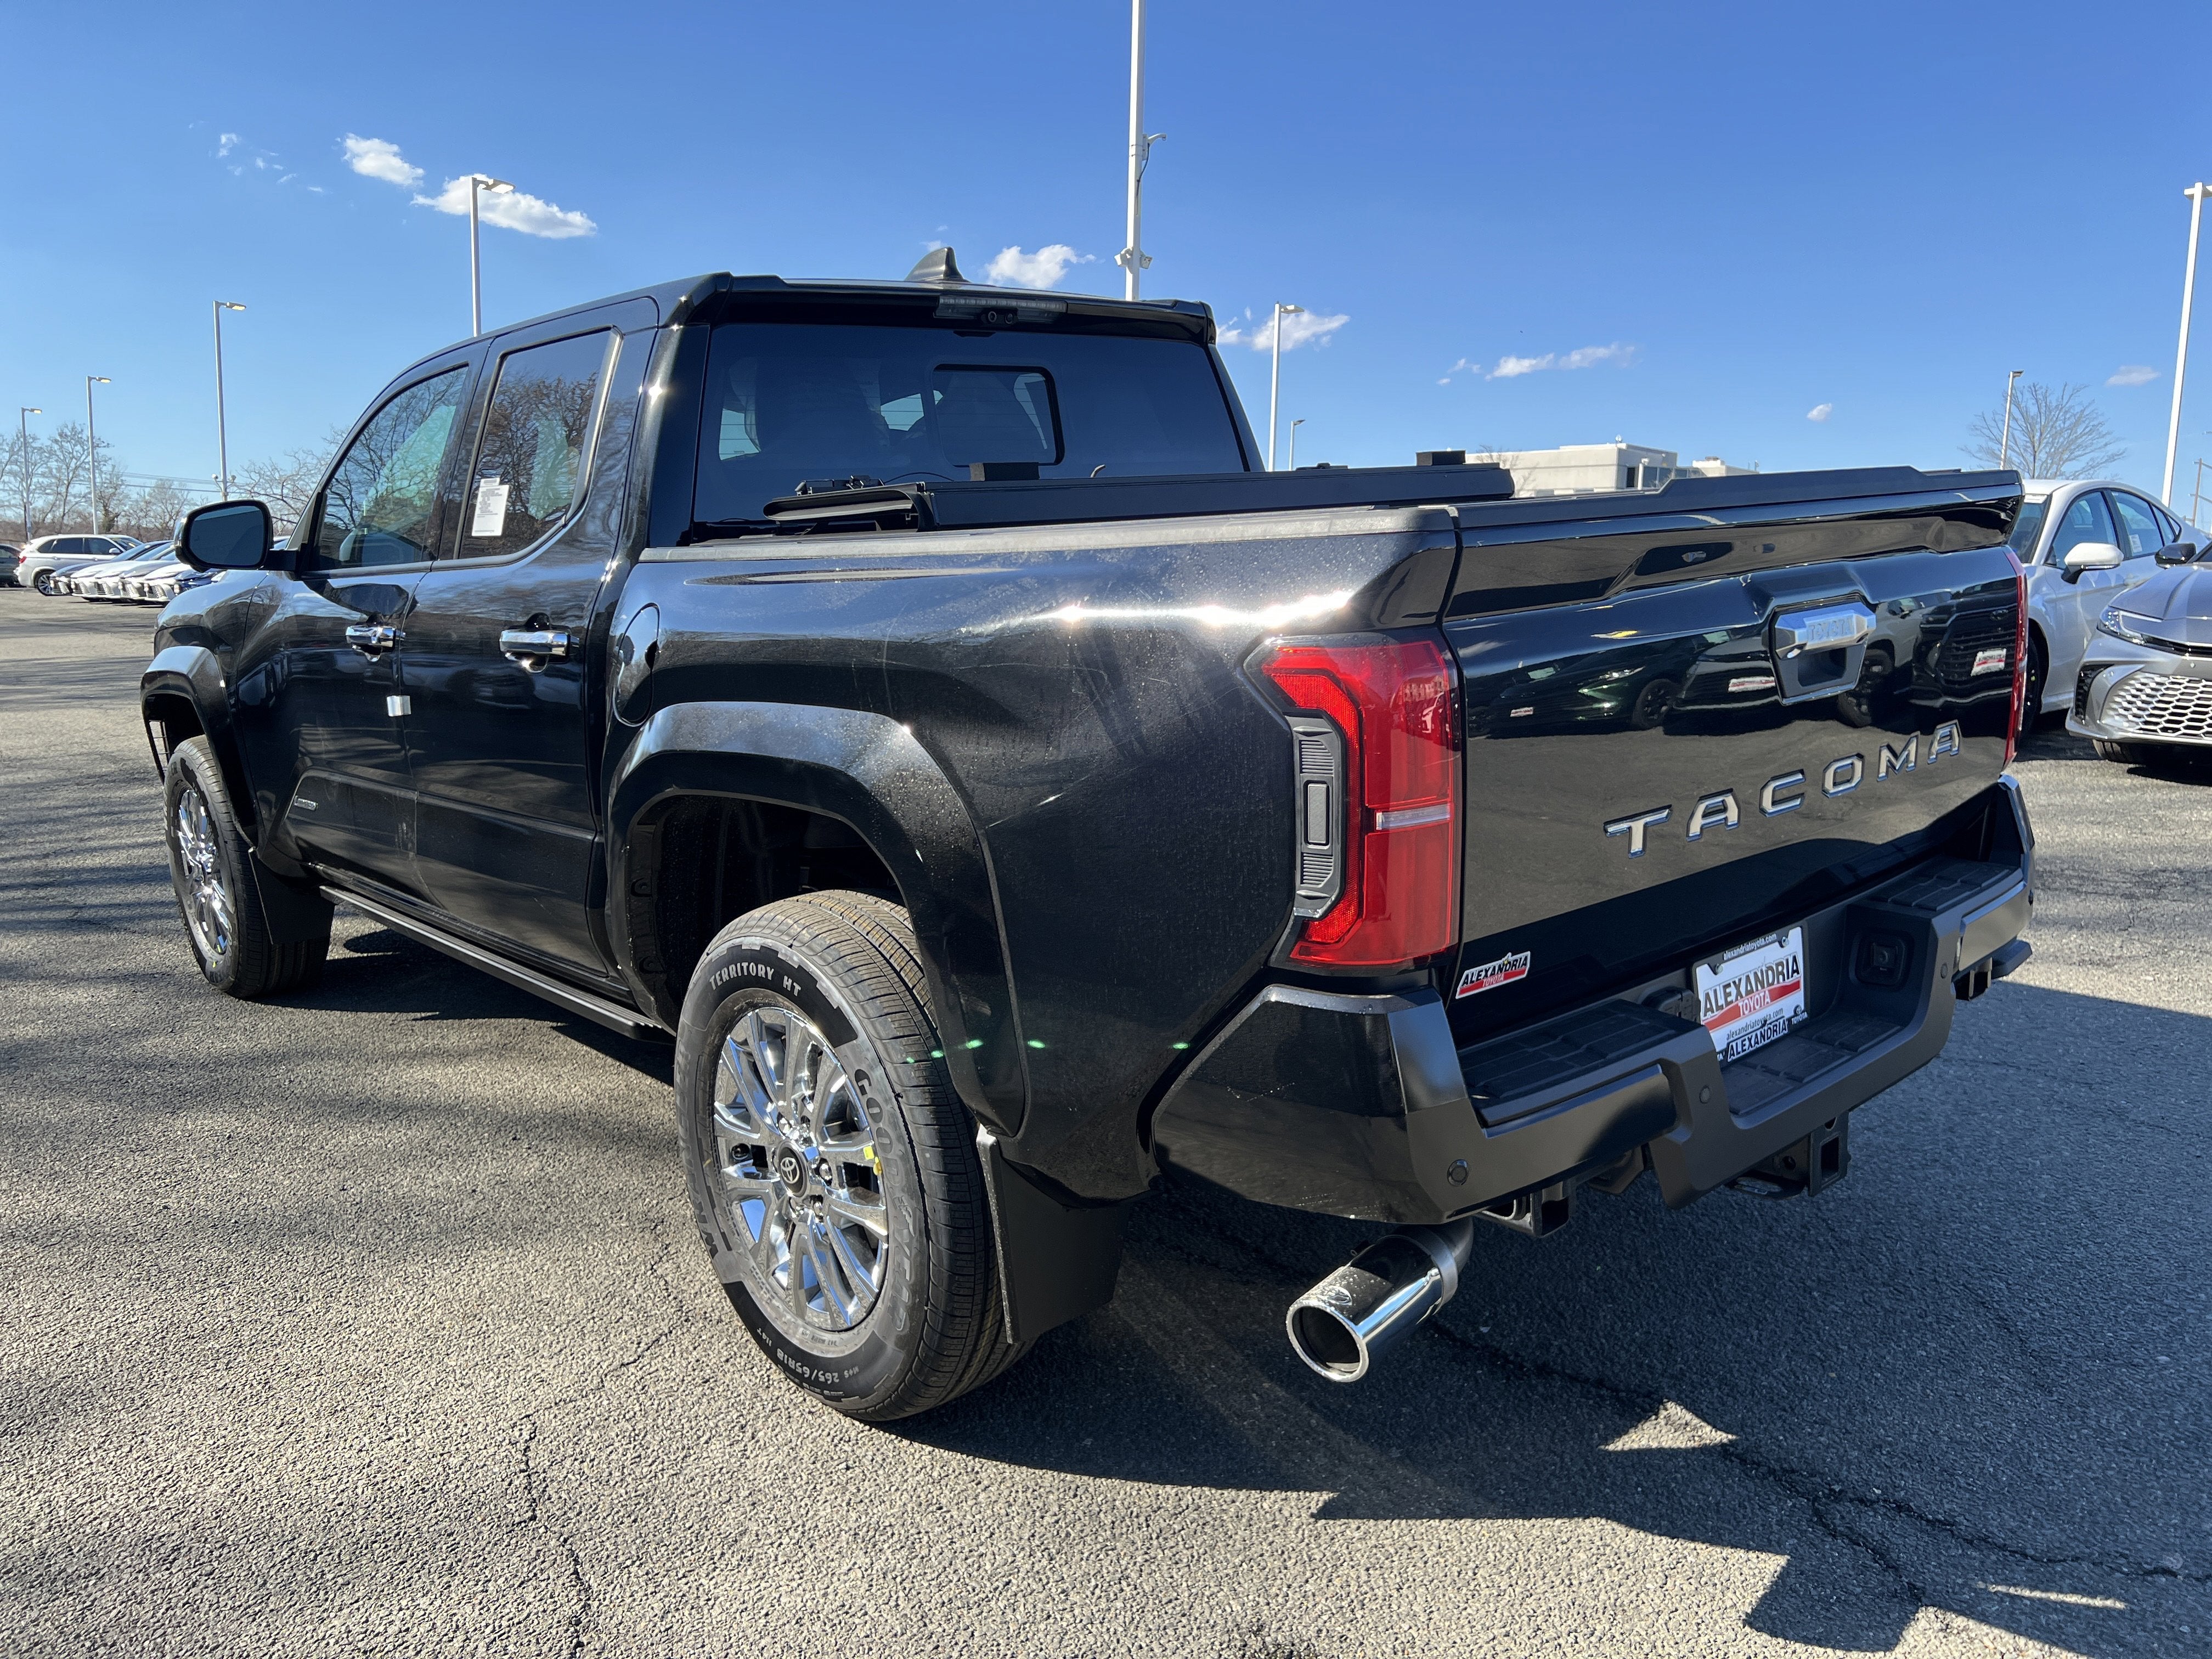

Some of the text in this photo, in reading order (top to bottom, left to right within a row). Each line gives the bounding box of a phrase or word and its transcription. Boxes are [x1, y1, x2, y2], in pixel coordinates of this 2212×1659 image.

[1808, 617, 1853, 641] TOYOTA
[1604, 719, 1962, 858] TACOMA
[1723, 933, 1777, 960] alexandriatoyota.com
[709, 962, 801, 997] TERRITORY HT
[1462, 956, 1528, 987] ALEXANDRIA
[1482, 973, 1504, 988] TOYOTA
[1703, 955, 1800, 1019] ALEXANDRIA
[1738, 990, 1771, 1017] TOYOTA
[1791, 1012, 1808, 1025] TOYOTA
[1728, 1019, 1787, 1060] ALEXANDRIA
[776, 1347, 839, 1385] 265/65R18
